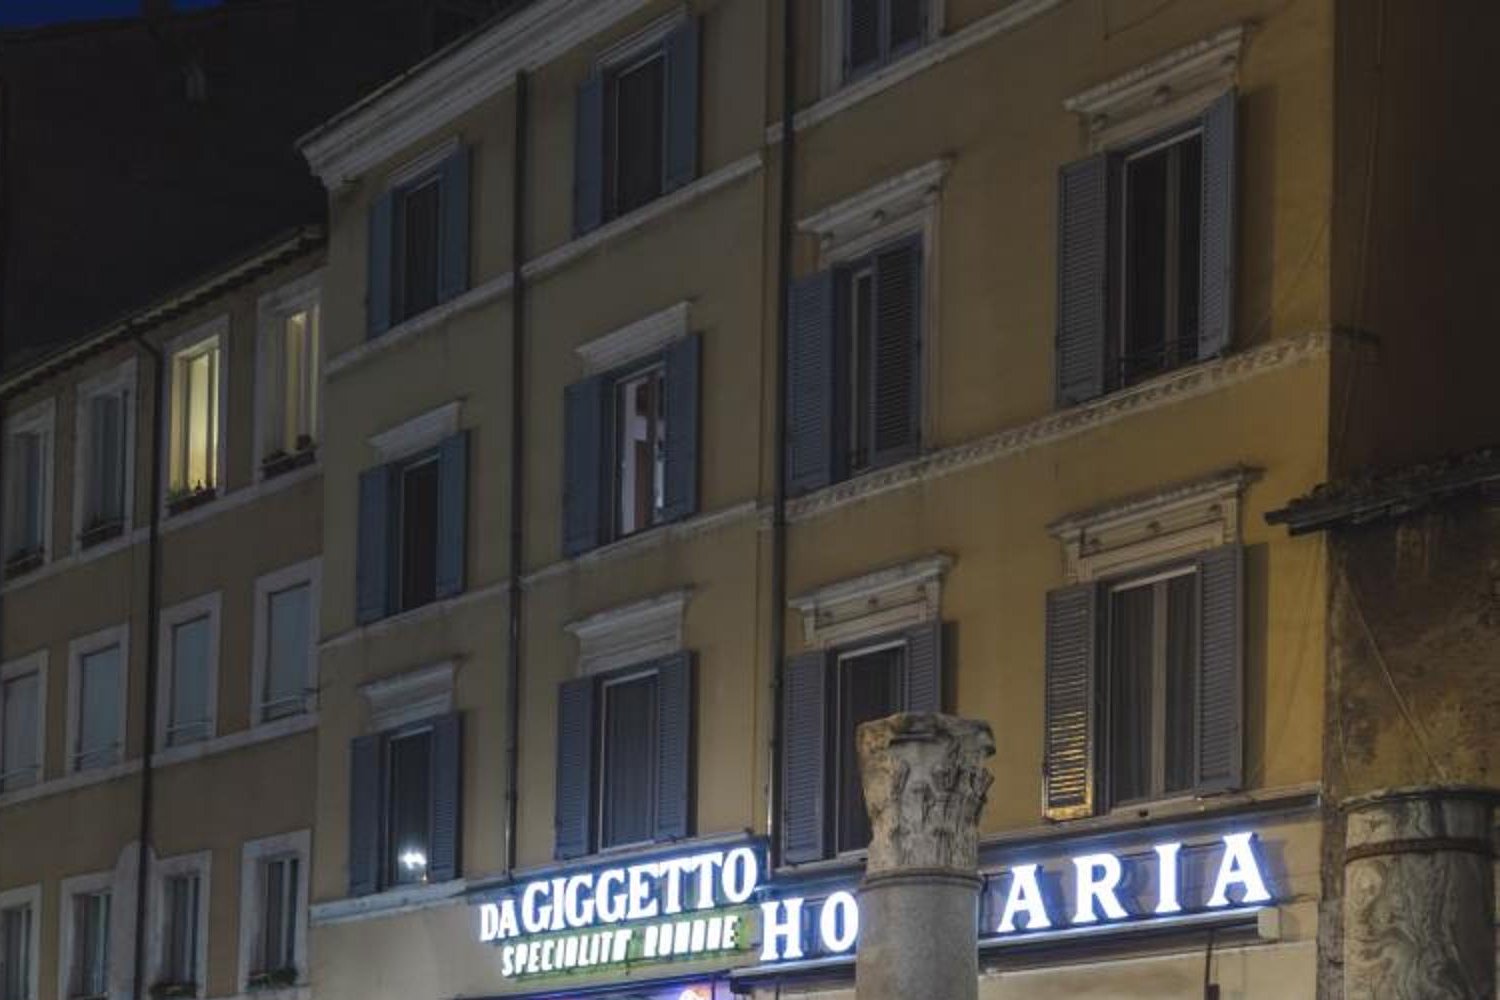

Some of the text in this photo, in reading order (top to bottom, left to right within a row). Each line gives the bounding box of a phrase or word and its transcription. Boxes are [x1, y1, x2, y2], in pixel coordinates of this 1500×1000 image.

[479, 846, 758, 942] DA GIGGETTO
[760, 831, 1272, 962] HOARIA
